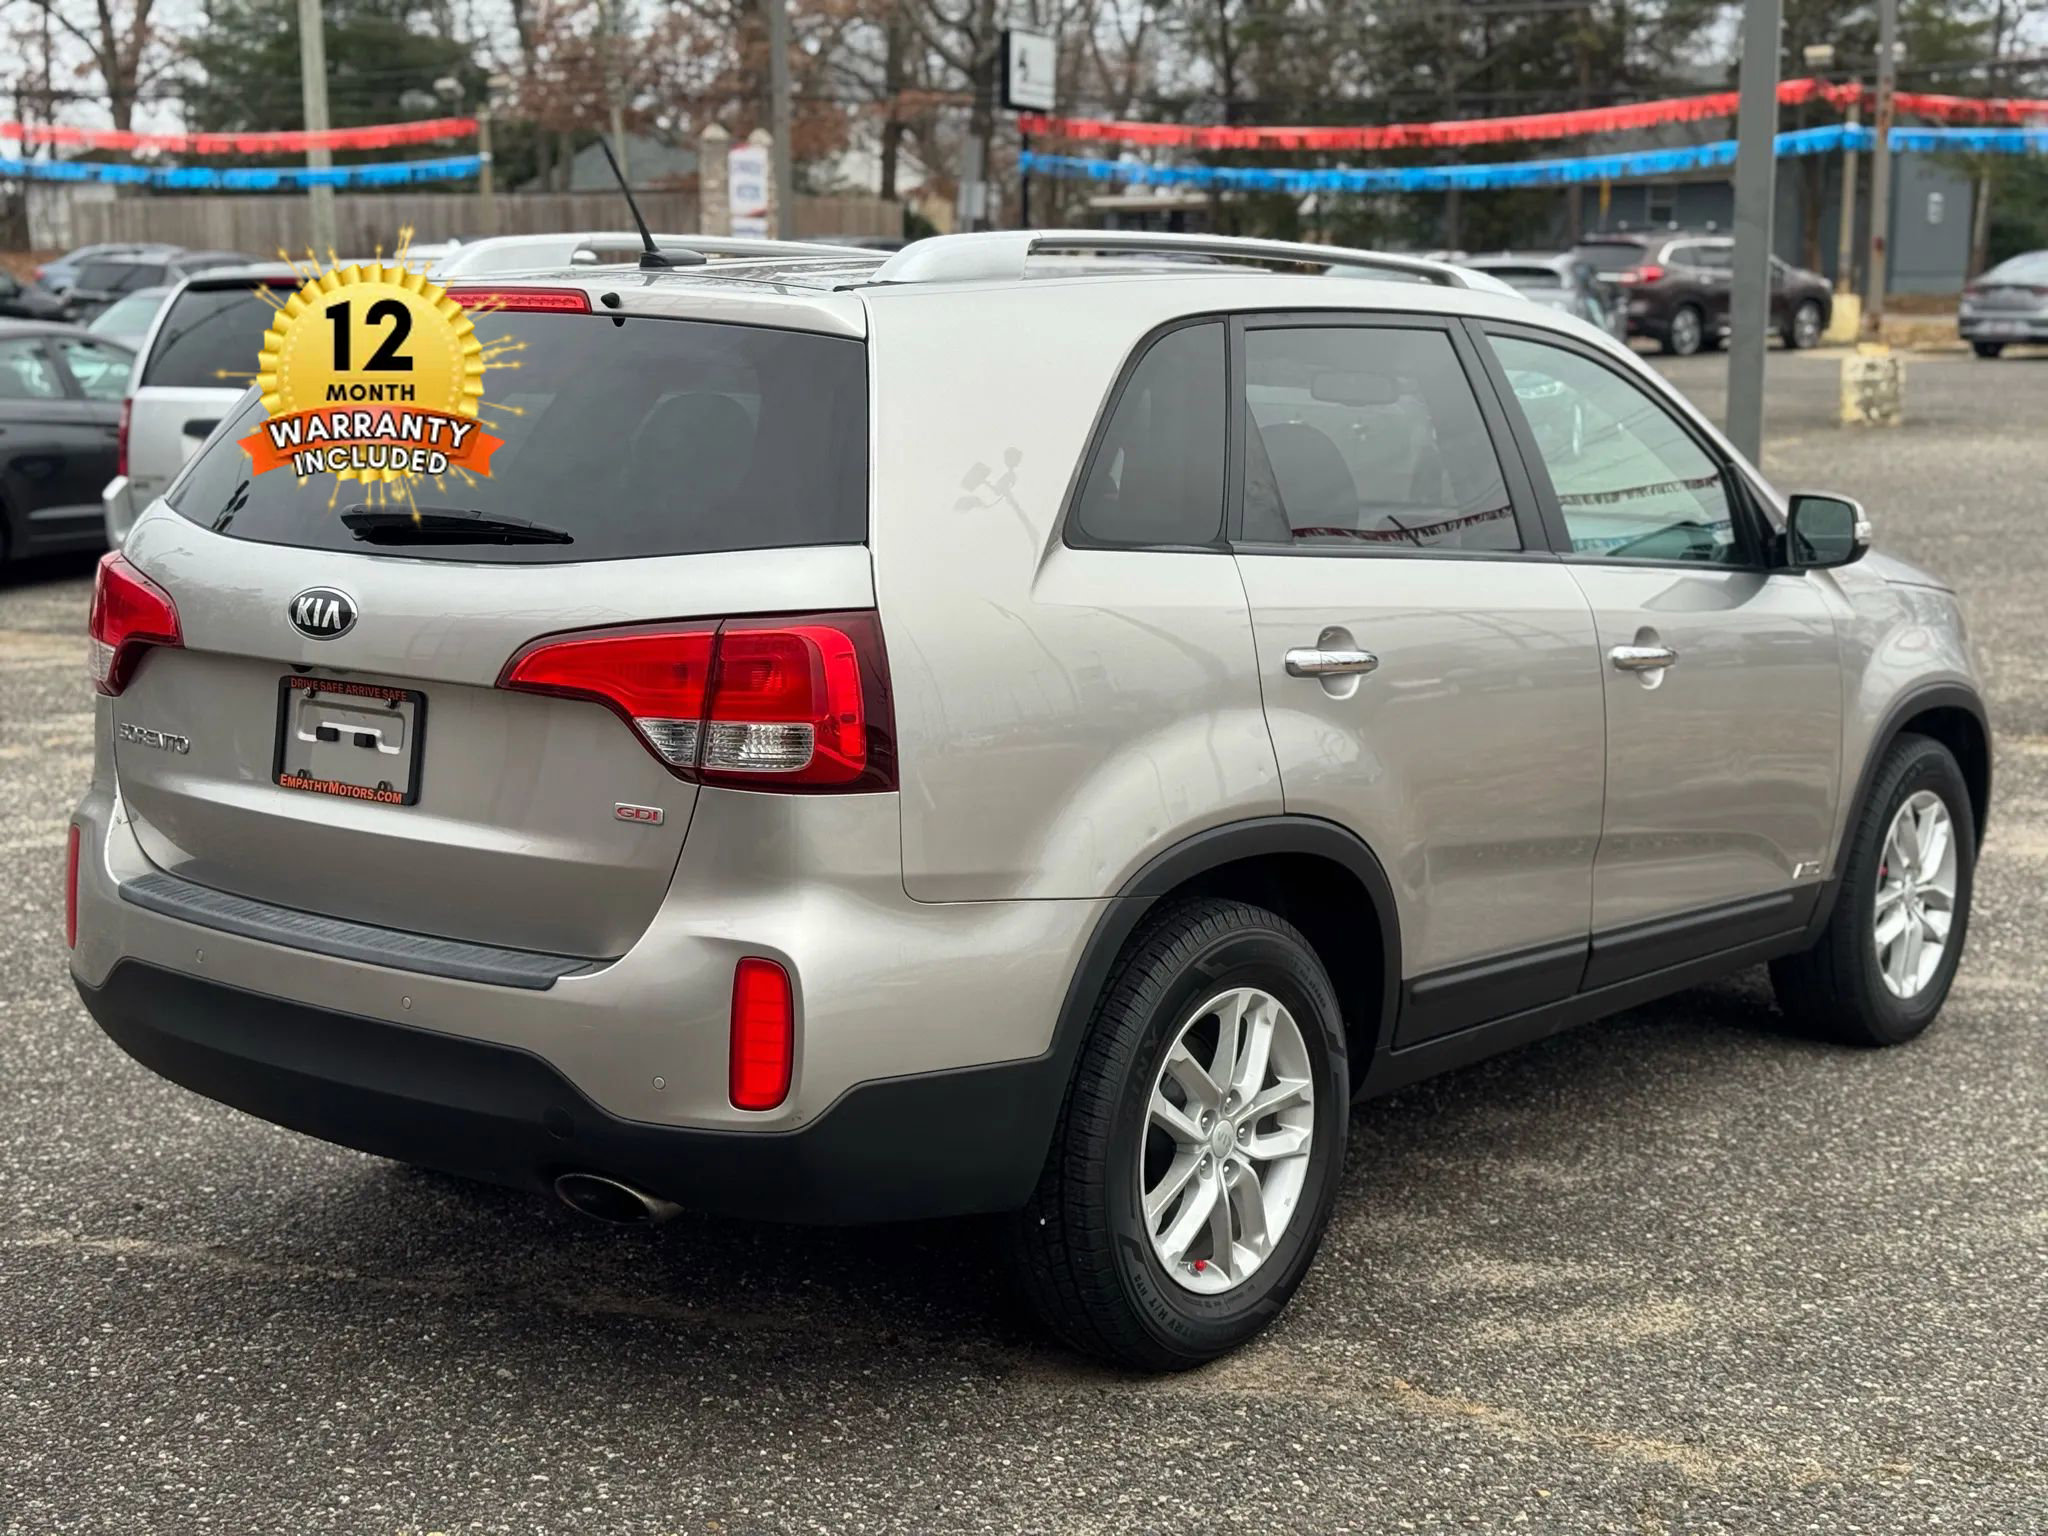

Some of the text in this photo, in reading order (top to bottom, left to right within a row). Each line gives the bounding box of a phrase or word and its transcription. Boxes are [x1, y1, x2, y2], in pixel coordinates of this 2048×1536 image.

[296, 597, 342, 630] KIA
[290, 677, 408, 701] DRIVE SAFE ARRIVE SAFE
[616, 807, 658, 821] GDI
